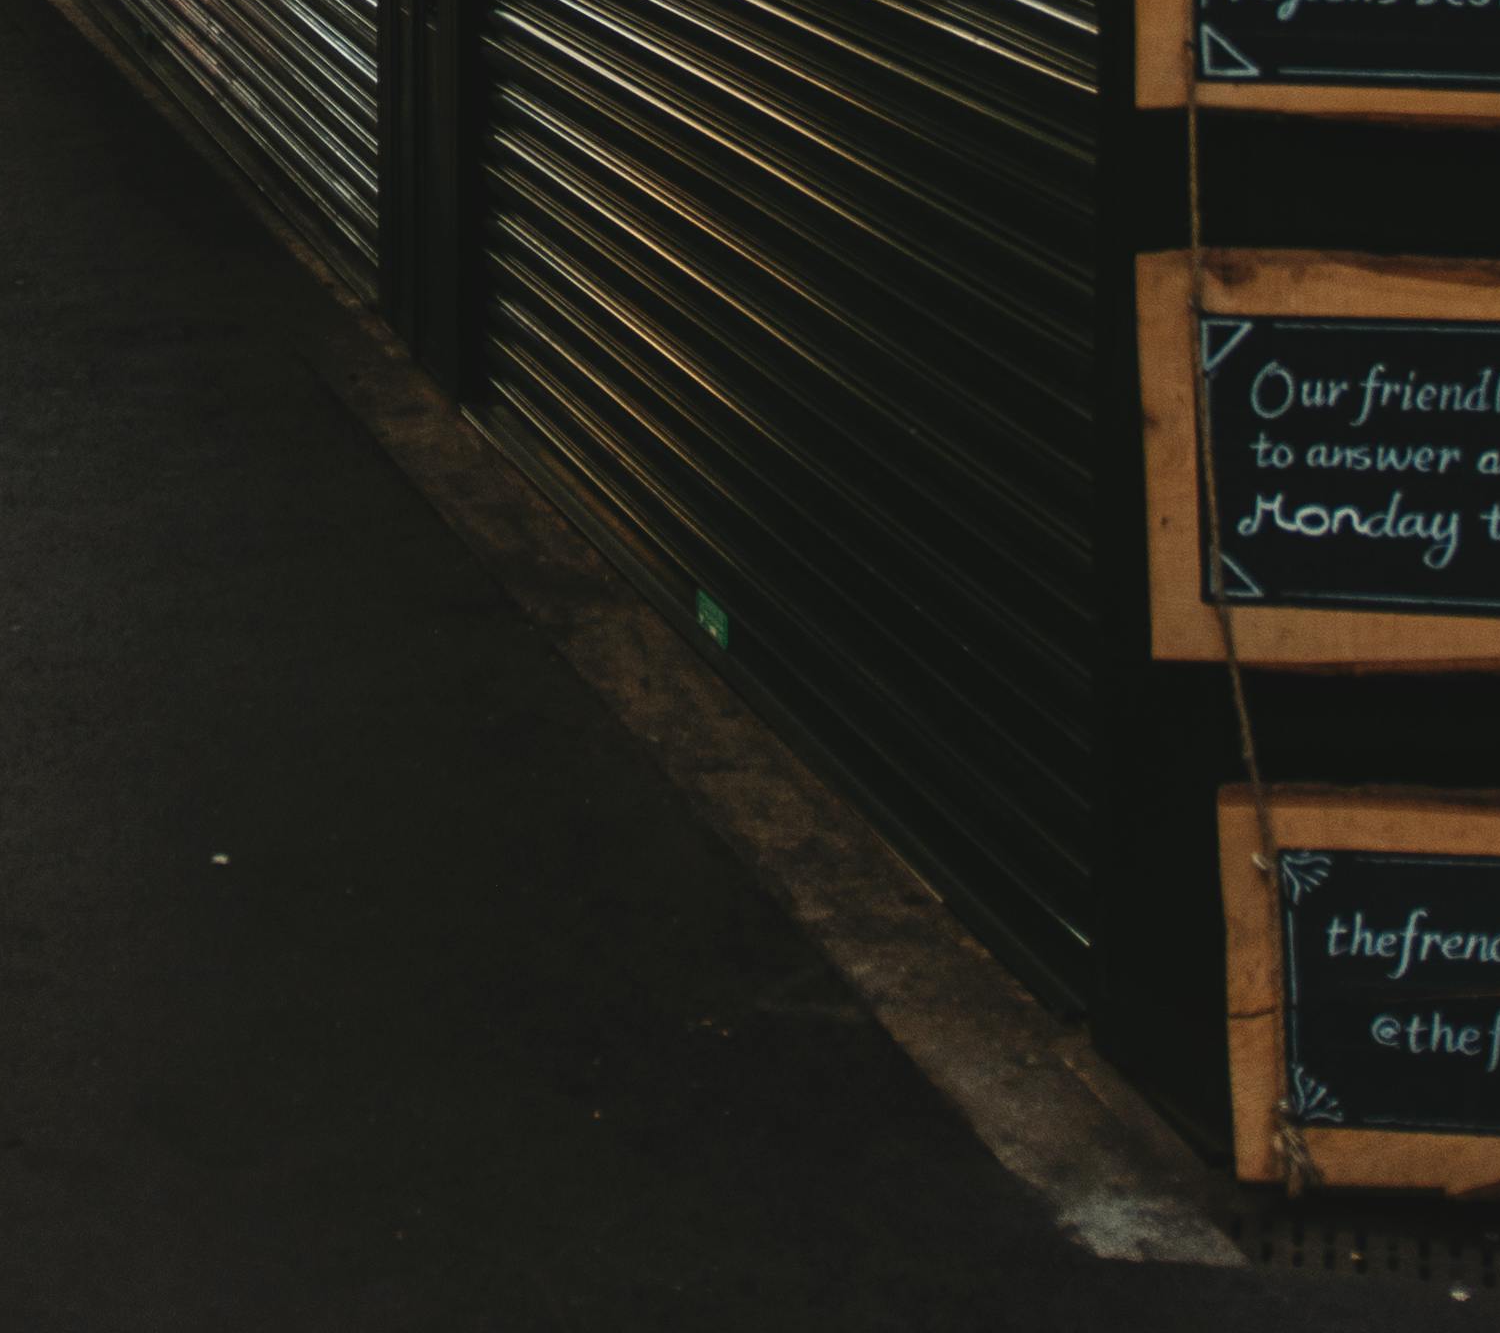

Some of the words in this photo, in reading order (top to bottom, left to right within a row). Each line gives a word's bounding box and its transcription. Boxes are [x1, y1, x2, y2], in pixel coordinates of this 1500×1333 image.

[1250, 361, 1349, 419] Our
[1250, 432, 1294, 471] to
[1306, 444, 1461, 474] answer
[1238, 492, 1461, 570] Monday
